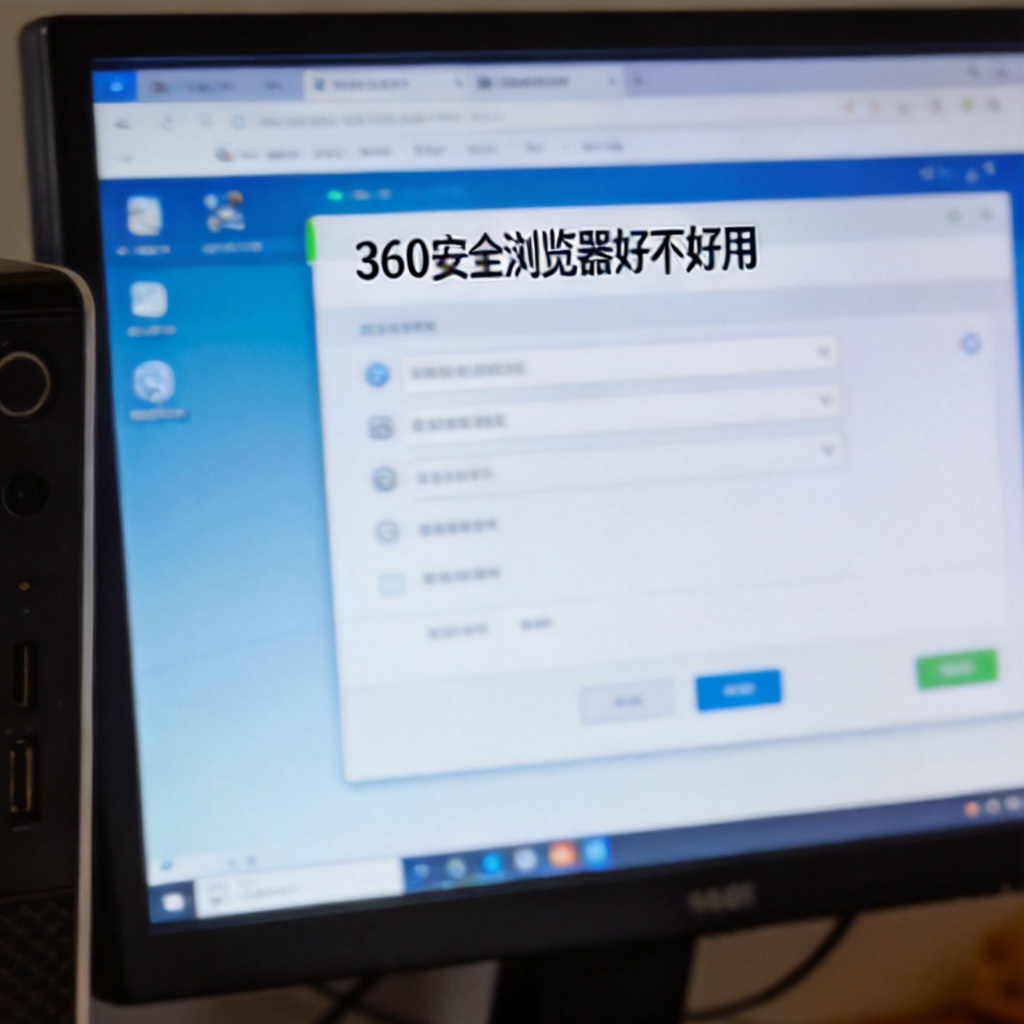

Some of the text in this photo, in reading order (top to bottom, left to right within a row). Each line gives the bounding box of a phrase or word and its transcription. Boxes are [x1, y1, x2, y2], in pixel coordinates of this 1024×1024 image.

[356, 226, 757, 281] 360安全浏览器好不好用
